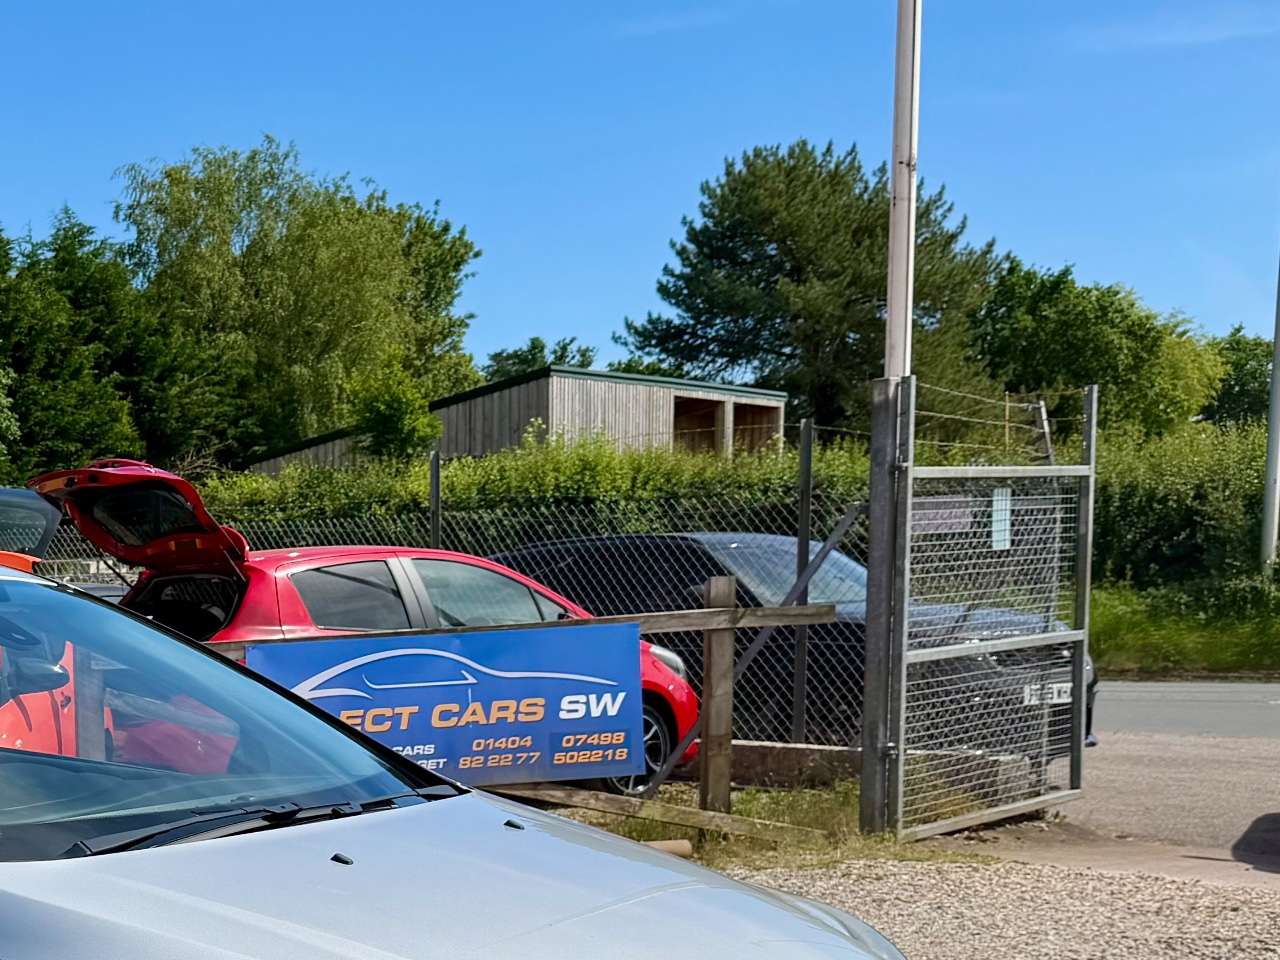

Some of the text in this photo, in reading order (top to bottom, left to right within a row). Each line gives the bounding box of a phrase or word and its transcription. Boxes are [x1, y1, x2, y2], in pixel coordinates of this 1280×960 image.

[431, 698, 545, 728] CARS
[559, 692, 626, 720] SW
[472, 736, 532, 751] 01404
[562, 732, 625, 748] 07498
[553, 748, 628, 764] 502218
